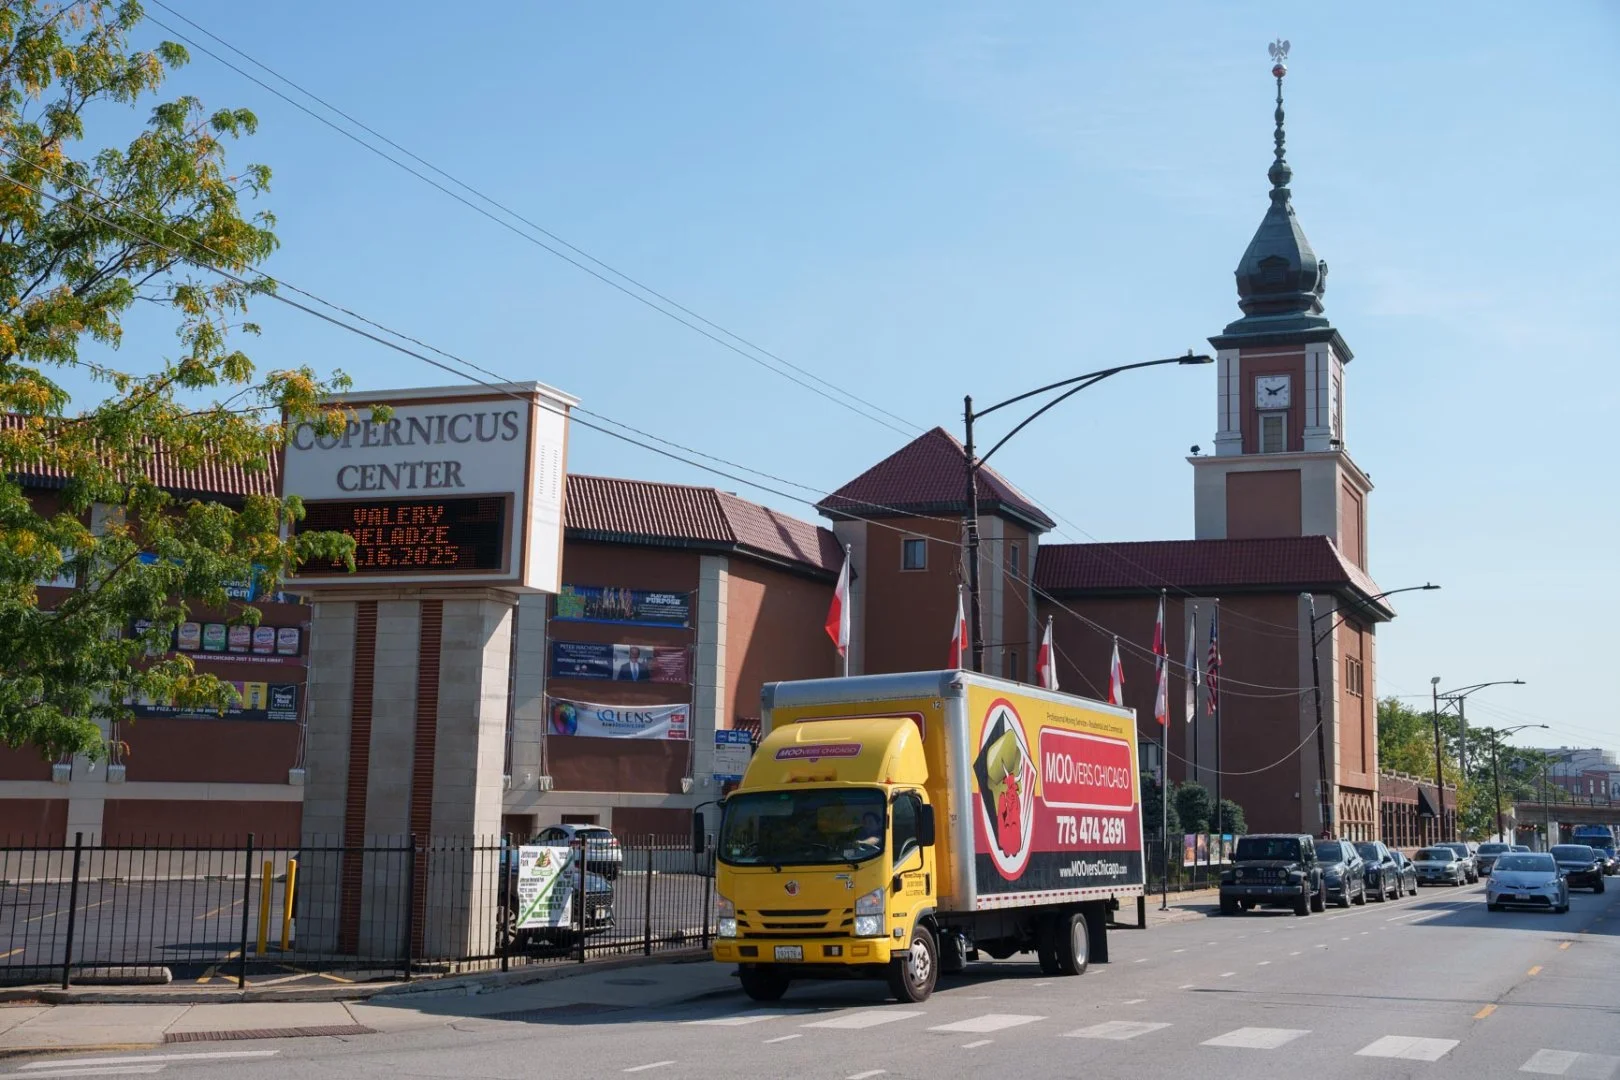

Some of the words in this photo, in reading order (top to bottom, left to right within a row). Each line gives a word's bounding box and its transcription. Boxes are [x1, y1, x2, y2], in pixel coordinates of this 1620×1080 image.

[293, 411, 519, 450] COPERNICUS
[337, 460, 465, 492] CENTER
[353, 505, 444, 525] VALERY
[331, 546, 459, 567] .16.2025
[225, 587, 250, 597] Gem
[1094, 764, 1129, 790] CHICAGO
[1056, 816, 1077, 845] 773
[1079, 816, 1101, 845] 474
[1101, 817, 1126, 845] 2691
[845, 880, 854, 889] 12
